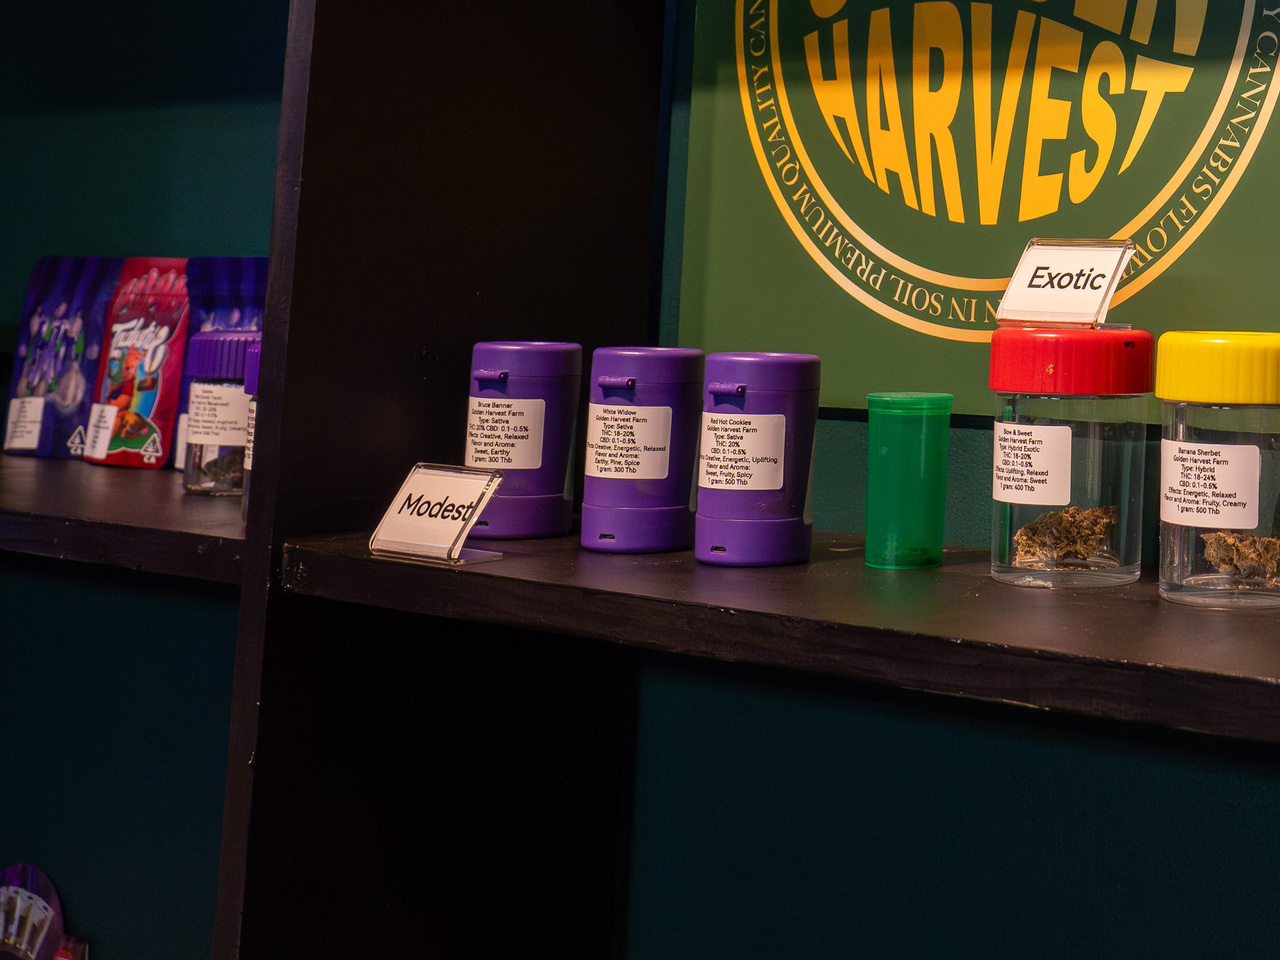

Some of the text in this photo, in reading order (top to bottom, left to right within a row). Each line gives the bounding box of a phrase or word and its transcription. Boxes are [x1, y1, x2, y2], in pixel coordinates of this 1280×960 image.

[751, 65, 803, 186] QUALITY
[803, 1, 1194, 225] HARVEST
[1192, 31, 1279, 201] CANNABIS
[793, 180, 884, 291] PREMIUM
[1119, 194, 1198, 280] FLOW
[1027, 266, 1106, 293] Exotic
[890, 274, 945, 316] SOIL
[948, 297, 981, 322] IN
[723, 456, 750, 464] Energetic,
[1178, 447, 1195, 455] Banana
[1182, 464, 1194, 472] Type:
[398, 493, 474, 521] Modest
[1183, 497, 1200, 505] Aroma:
[1184, 489, 1210, 498] Energetic,
